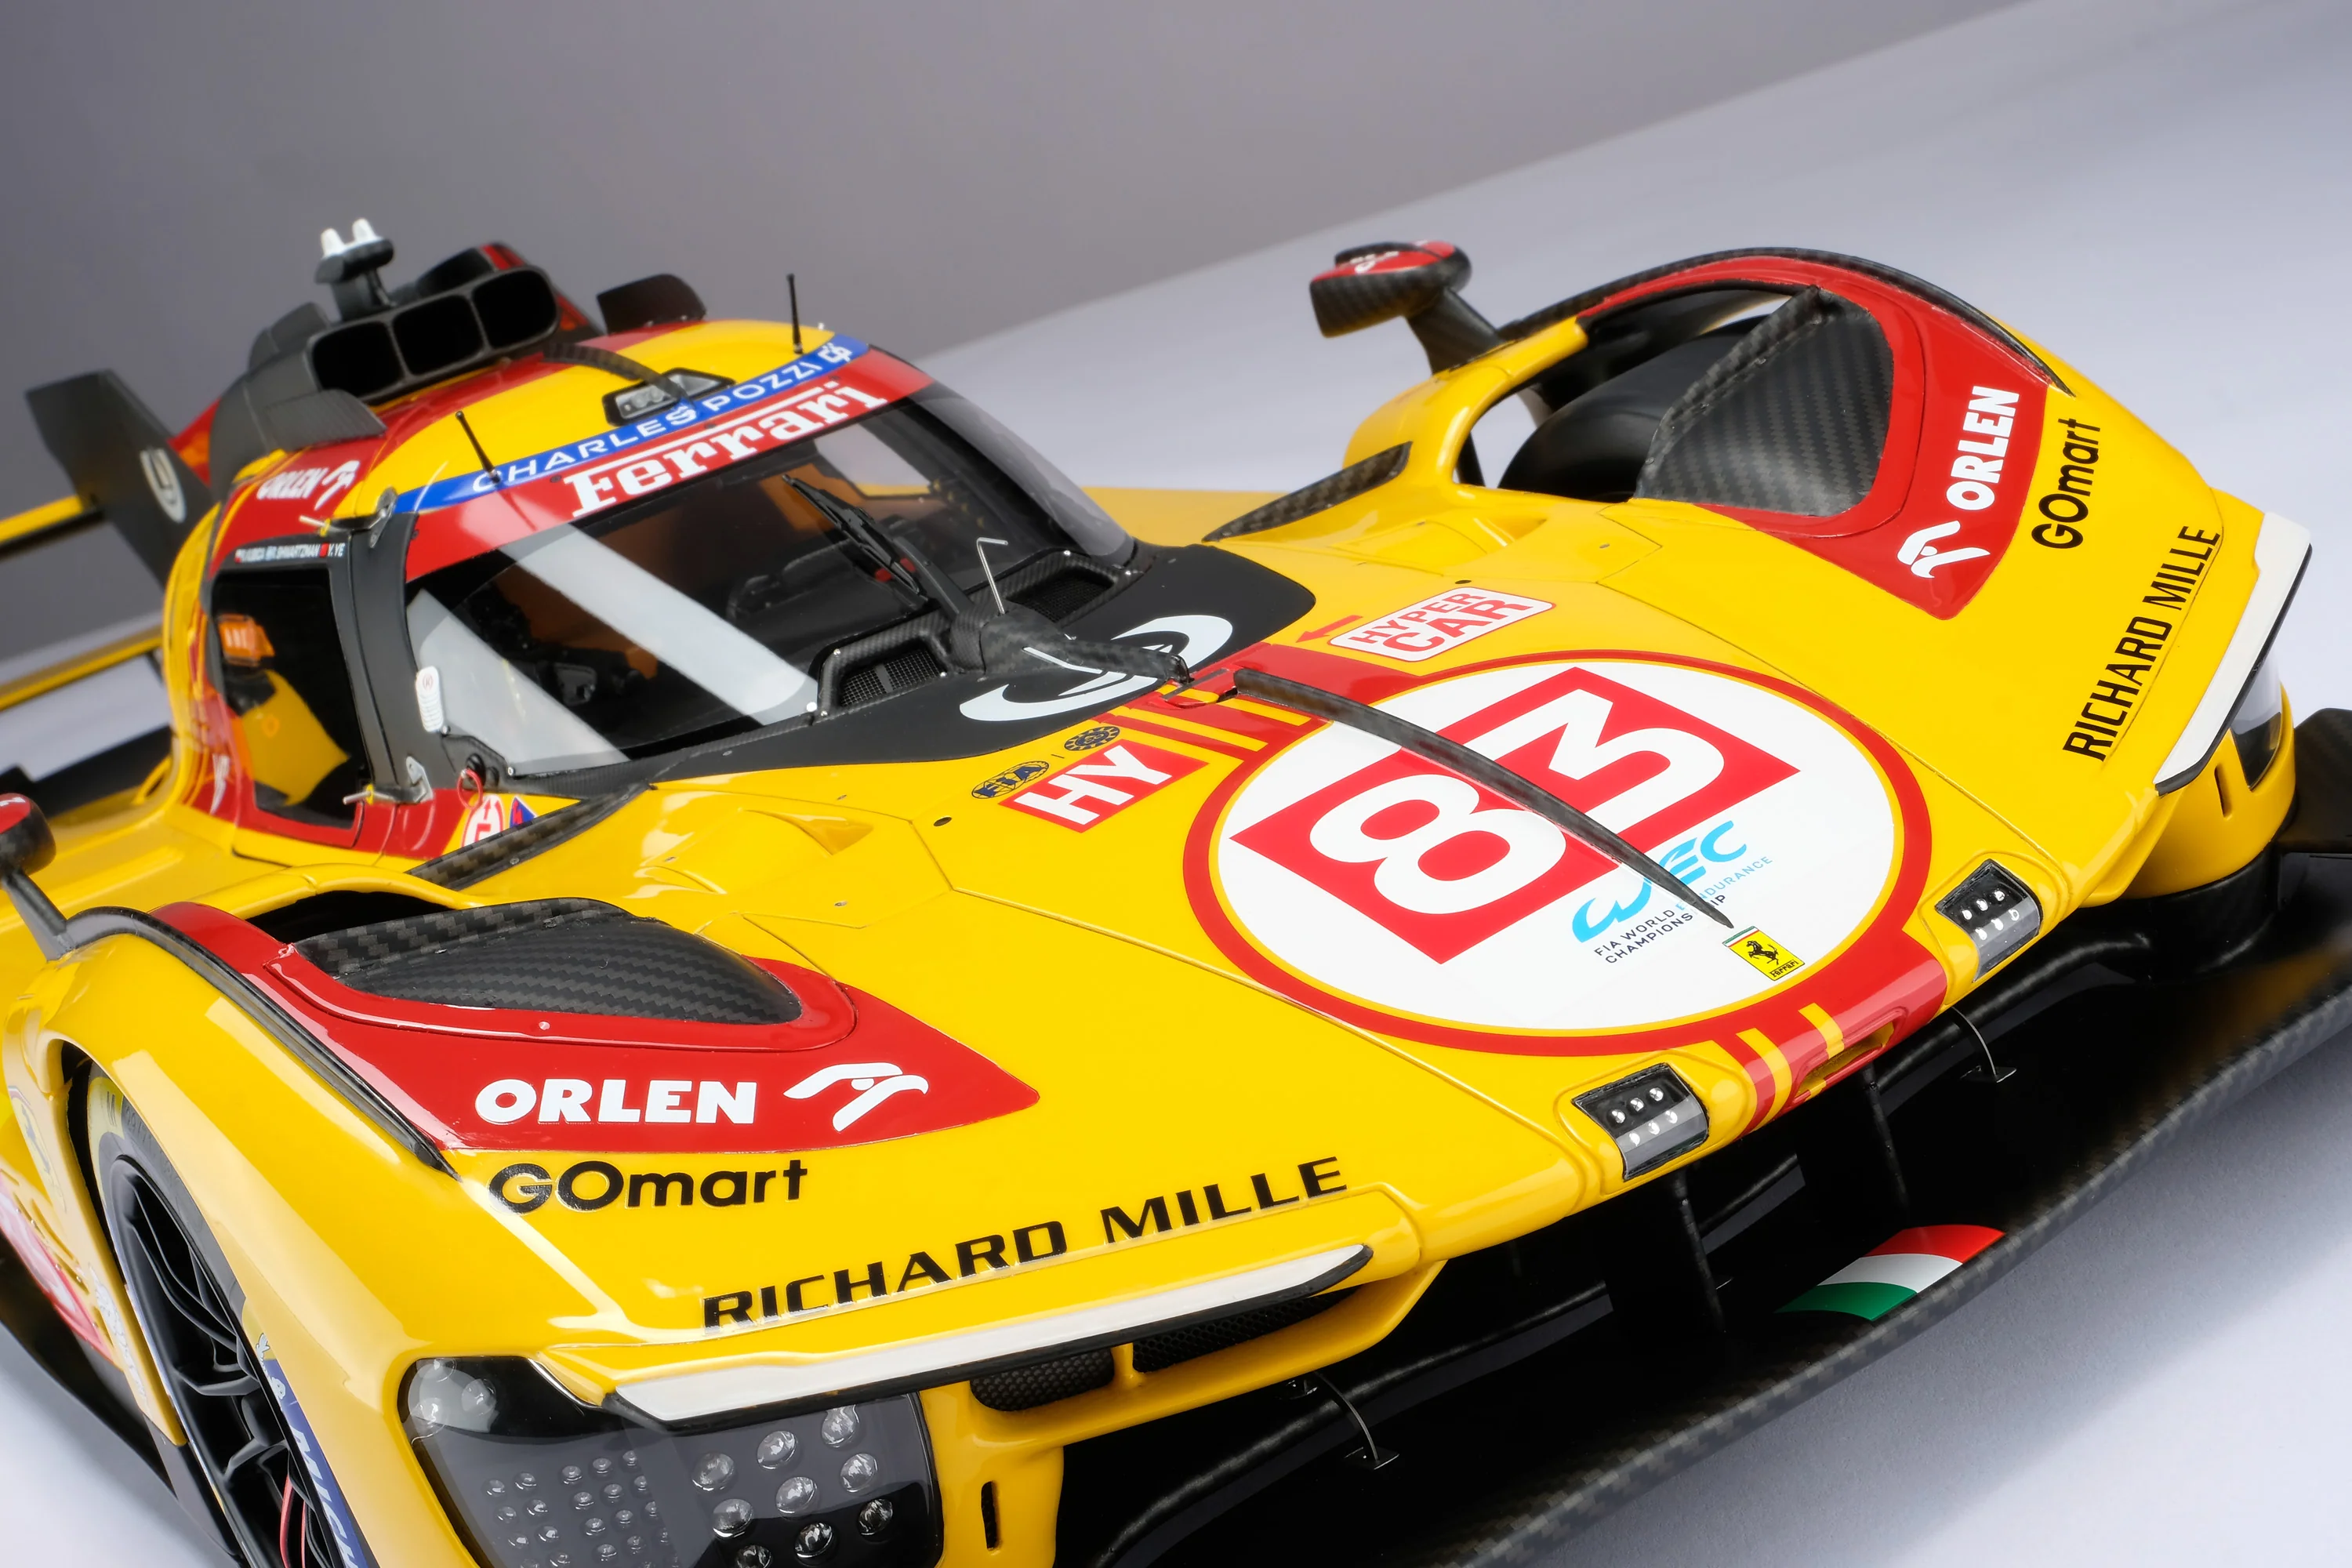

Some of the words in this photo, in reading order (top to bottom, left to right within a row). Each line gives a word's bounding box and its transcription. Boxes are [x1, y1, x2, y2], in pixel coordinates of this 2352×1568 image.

[472, 405, 697, 492] CHARLES
[702, 361, 822, 412] POZZI
[563, 381, 888, 518] Ferrari
[1946, 386, 2020, 510] ORLEN
[2031, 418, 2100, 549] GOmart
[1348, 593, 1486, 644] HYPER
[1383, 600, 1534, 652] CAR
[2062, 616, 2172, 761] RICHARD
[2142, 525, 2220, 611] MILLE
[974, 766, 1044, 797] FIA
[1014, 743, 1174, 826] HY
[1310, 689, 1725, 915] 83
[1572, 820, 1747, 942] WEC
[1594, 941, 1617, 956] FIA
[1621, 909, 1675, 940] WORLD
[1605, 895, 1726, 964] CHAMPIONSIP
[1769, 959, 1799, 978] Ferrari
[475, 1079, 757, 1124] ORLEN
[488, 1160, 808, 1214] GOmart
[704, 1220, 1067, 1332] RICHARD
[1098, 1156, 1346, 1245] MILLE
